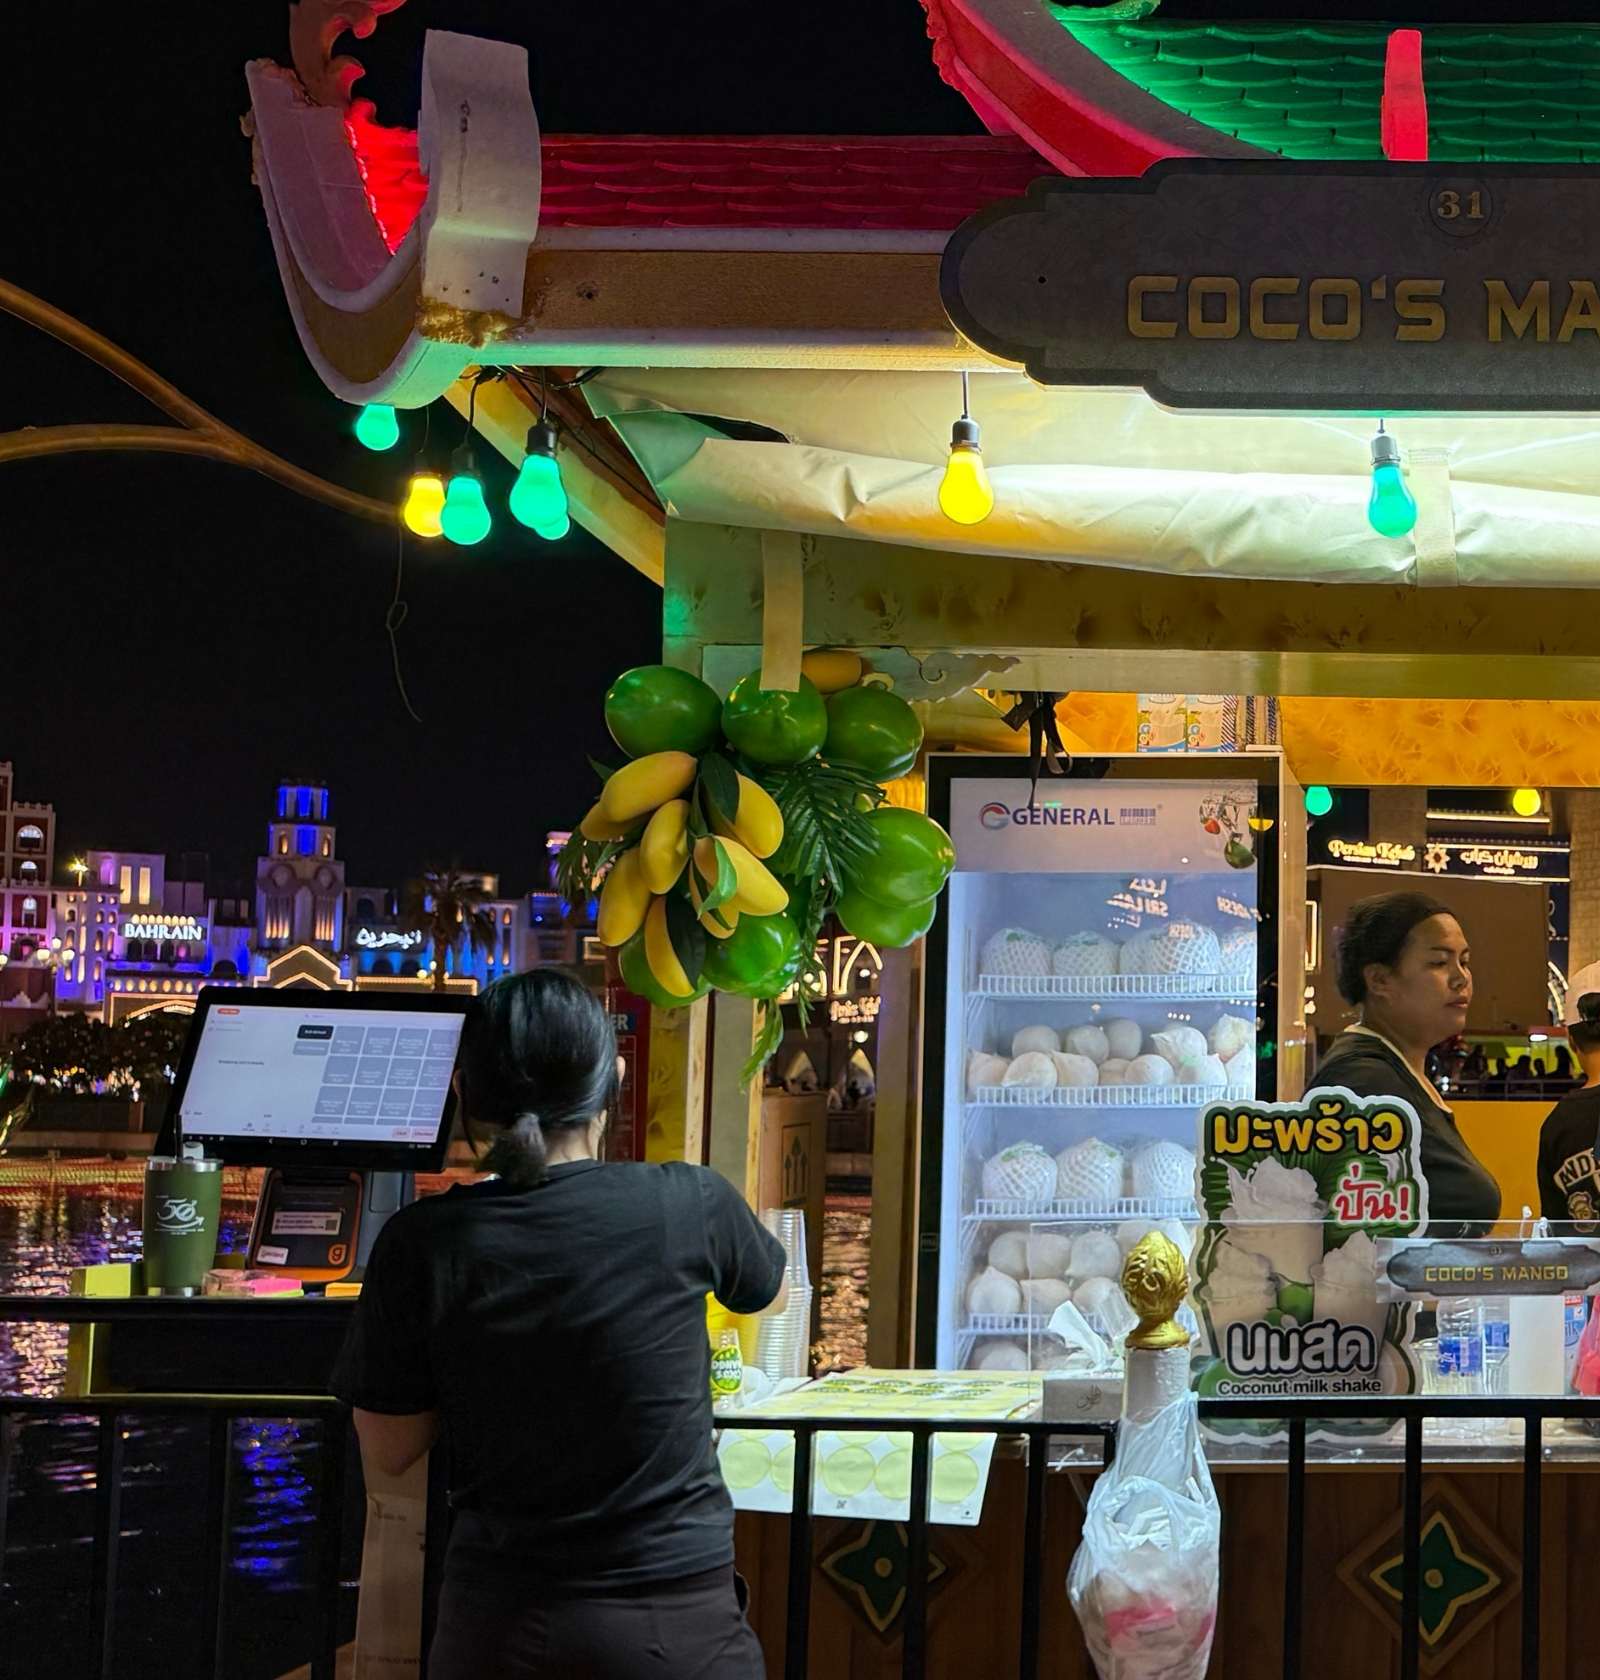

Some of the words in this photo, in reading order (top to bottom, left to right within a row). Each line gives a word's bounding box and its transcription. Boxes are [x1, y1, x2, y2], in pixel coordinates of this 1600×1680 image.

[1437, 190, 1485, 220] 31
[1012, 807, 1116, 826] GENERAL
[124, 922, 202, 941] BAHRAIN
[1213, 1102, 1405, 1154] มะพร้าว
[1425, 1265, 1495, 1282] COCO'S
[1501, 1264, 1569, 1281] MANGO
[1228, 1319, 1376, 1375] นมสด
[1218, 1380, 1289, 1395] Coconut
[1293, 1378, 1329, 1394] milk
[1332, 1377, 1382, 1393] shake
